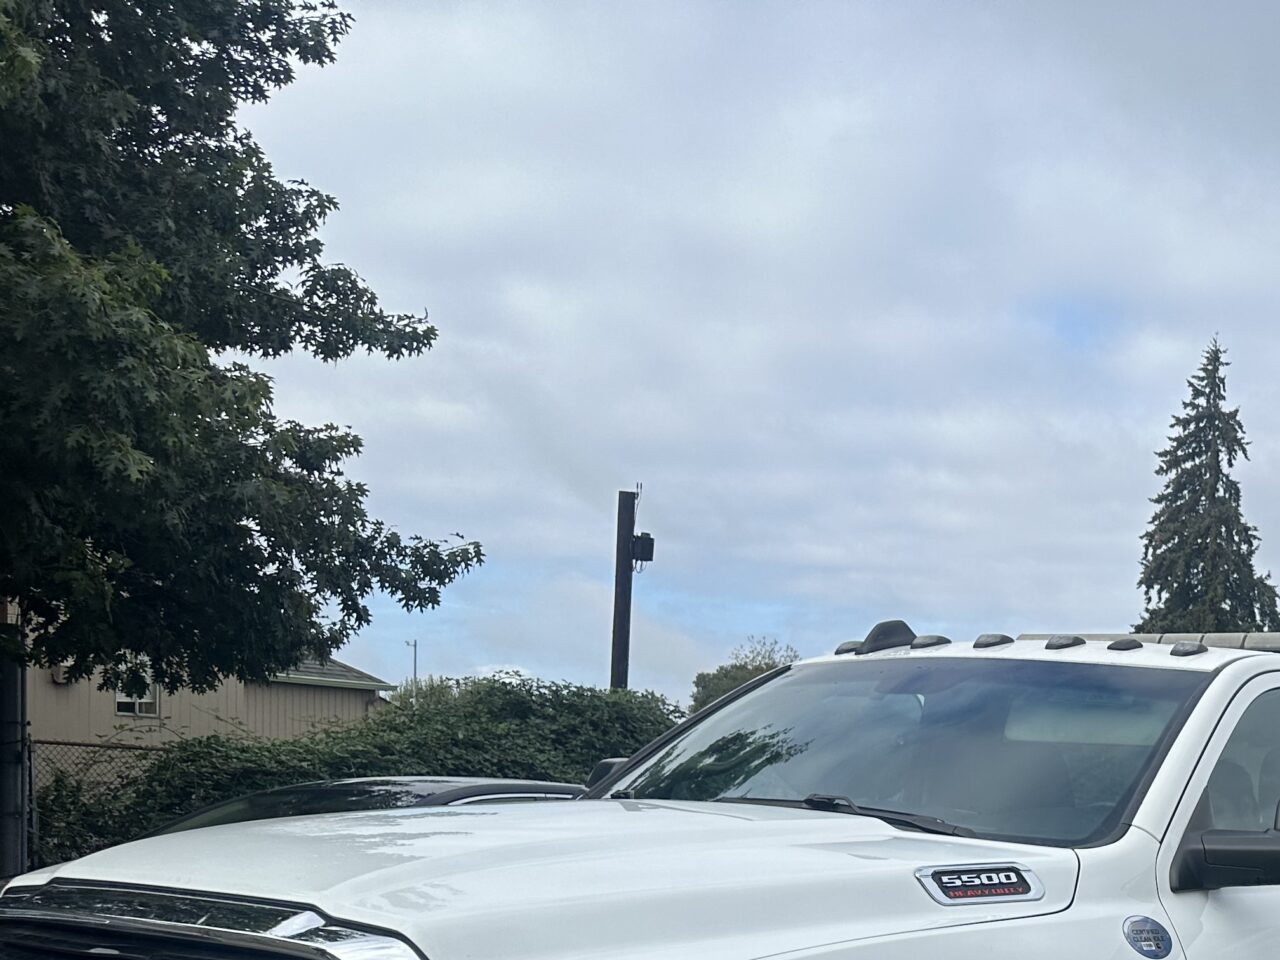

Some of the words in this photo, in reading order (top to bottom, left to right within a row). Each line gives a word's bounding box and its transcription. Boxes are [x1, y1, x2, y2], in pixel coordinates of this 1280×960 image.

[940, 872, 1018, 887] 5500
[948, 888, 989, 897] HEAVY
[991, 886, 1025, 896] DUTY
